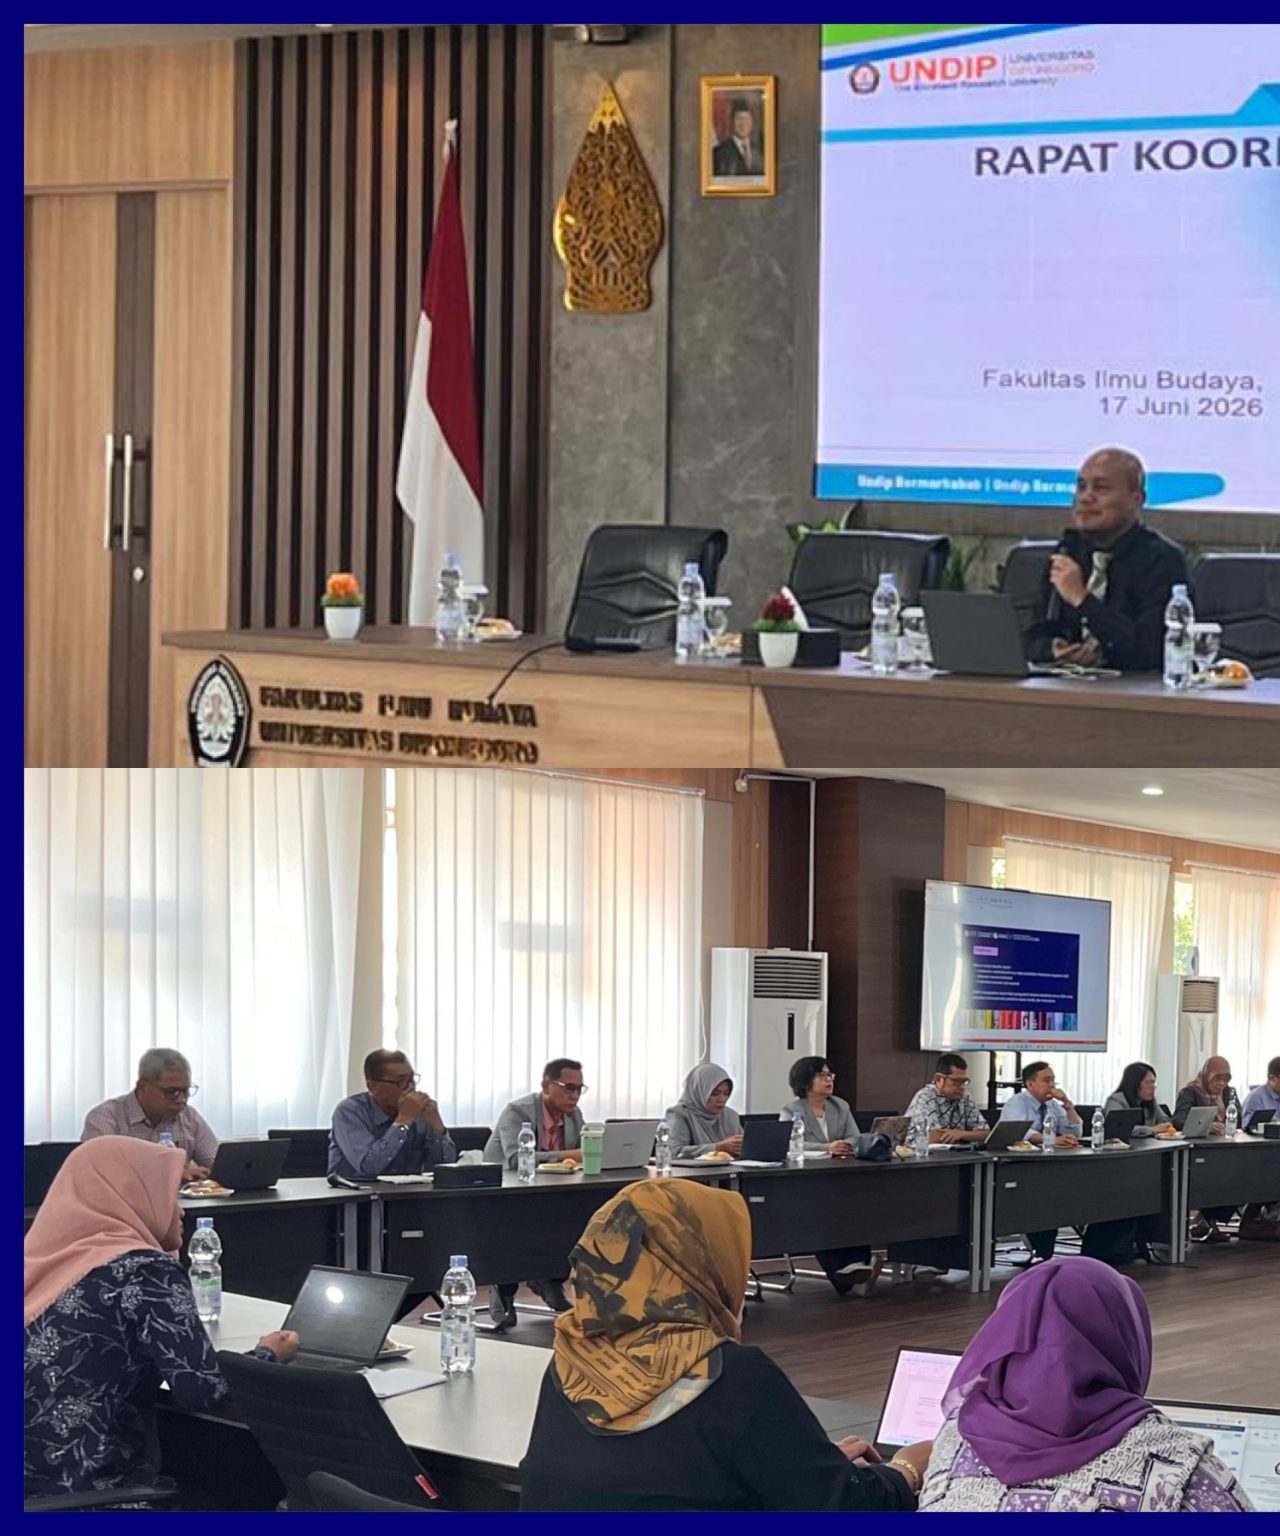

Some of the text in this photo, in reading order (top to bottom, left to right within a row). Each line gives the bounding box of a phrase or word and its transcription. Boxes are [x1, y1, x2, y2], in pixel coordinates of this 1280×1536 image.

[889, 56, 997, 82] UNDIP
[974, 142, 1118, 176] RAPAT
[983, 369, 1263, 394] Fakultas Ilmu Budaya,
[1100, 397, 1263, 417] 17 Juni 2026
[857, 474, 893, 491] Undip
[993, 479, 1030, 495] Undip
[259, 685, 364, 714] FAKULTAS
